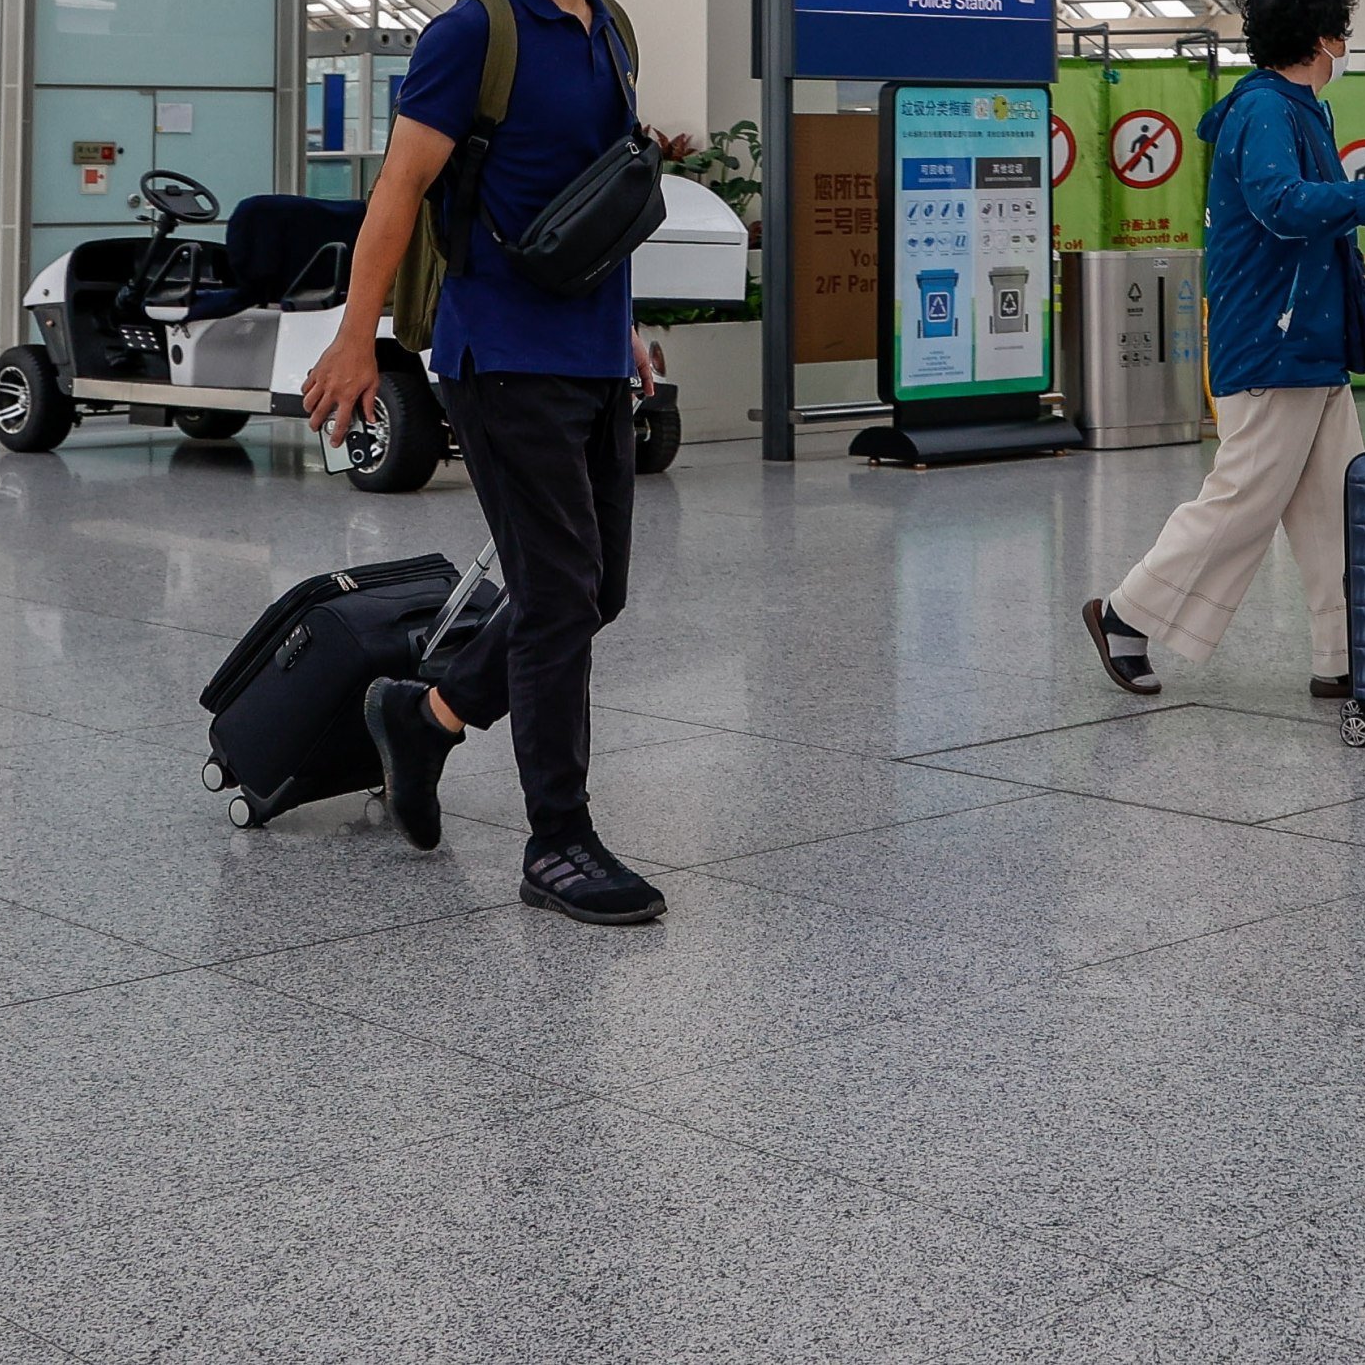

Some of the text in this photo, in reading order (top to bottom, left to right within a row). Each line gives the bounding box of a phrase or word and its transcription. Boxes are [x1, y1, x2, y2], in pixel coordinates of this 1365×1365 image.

[901, 100, 972, 118] 垃圾分类指南
[814, 172, 878, 201] 您所在
[814, 207, 878, 235] 三号停
[815, 275, 841, 295] 2/F
